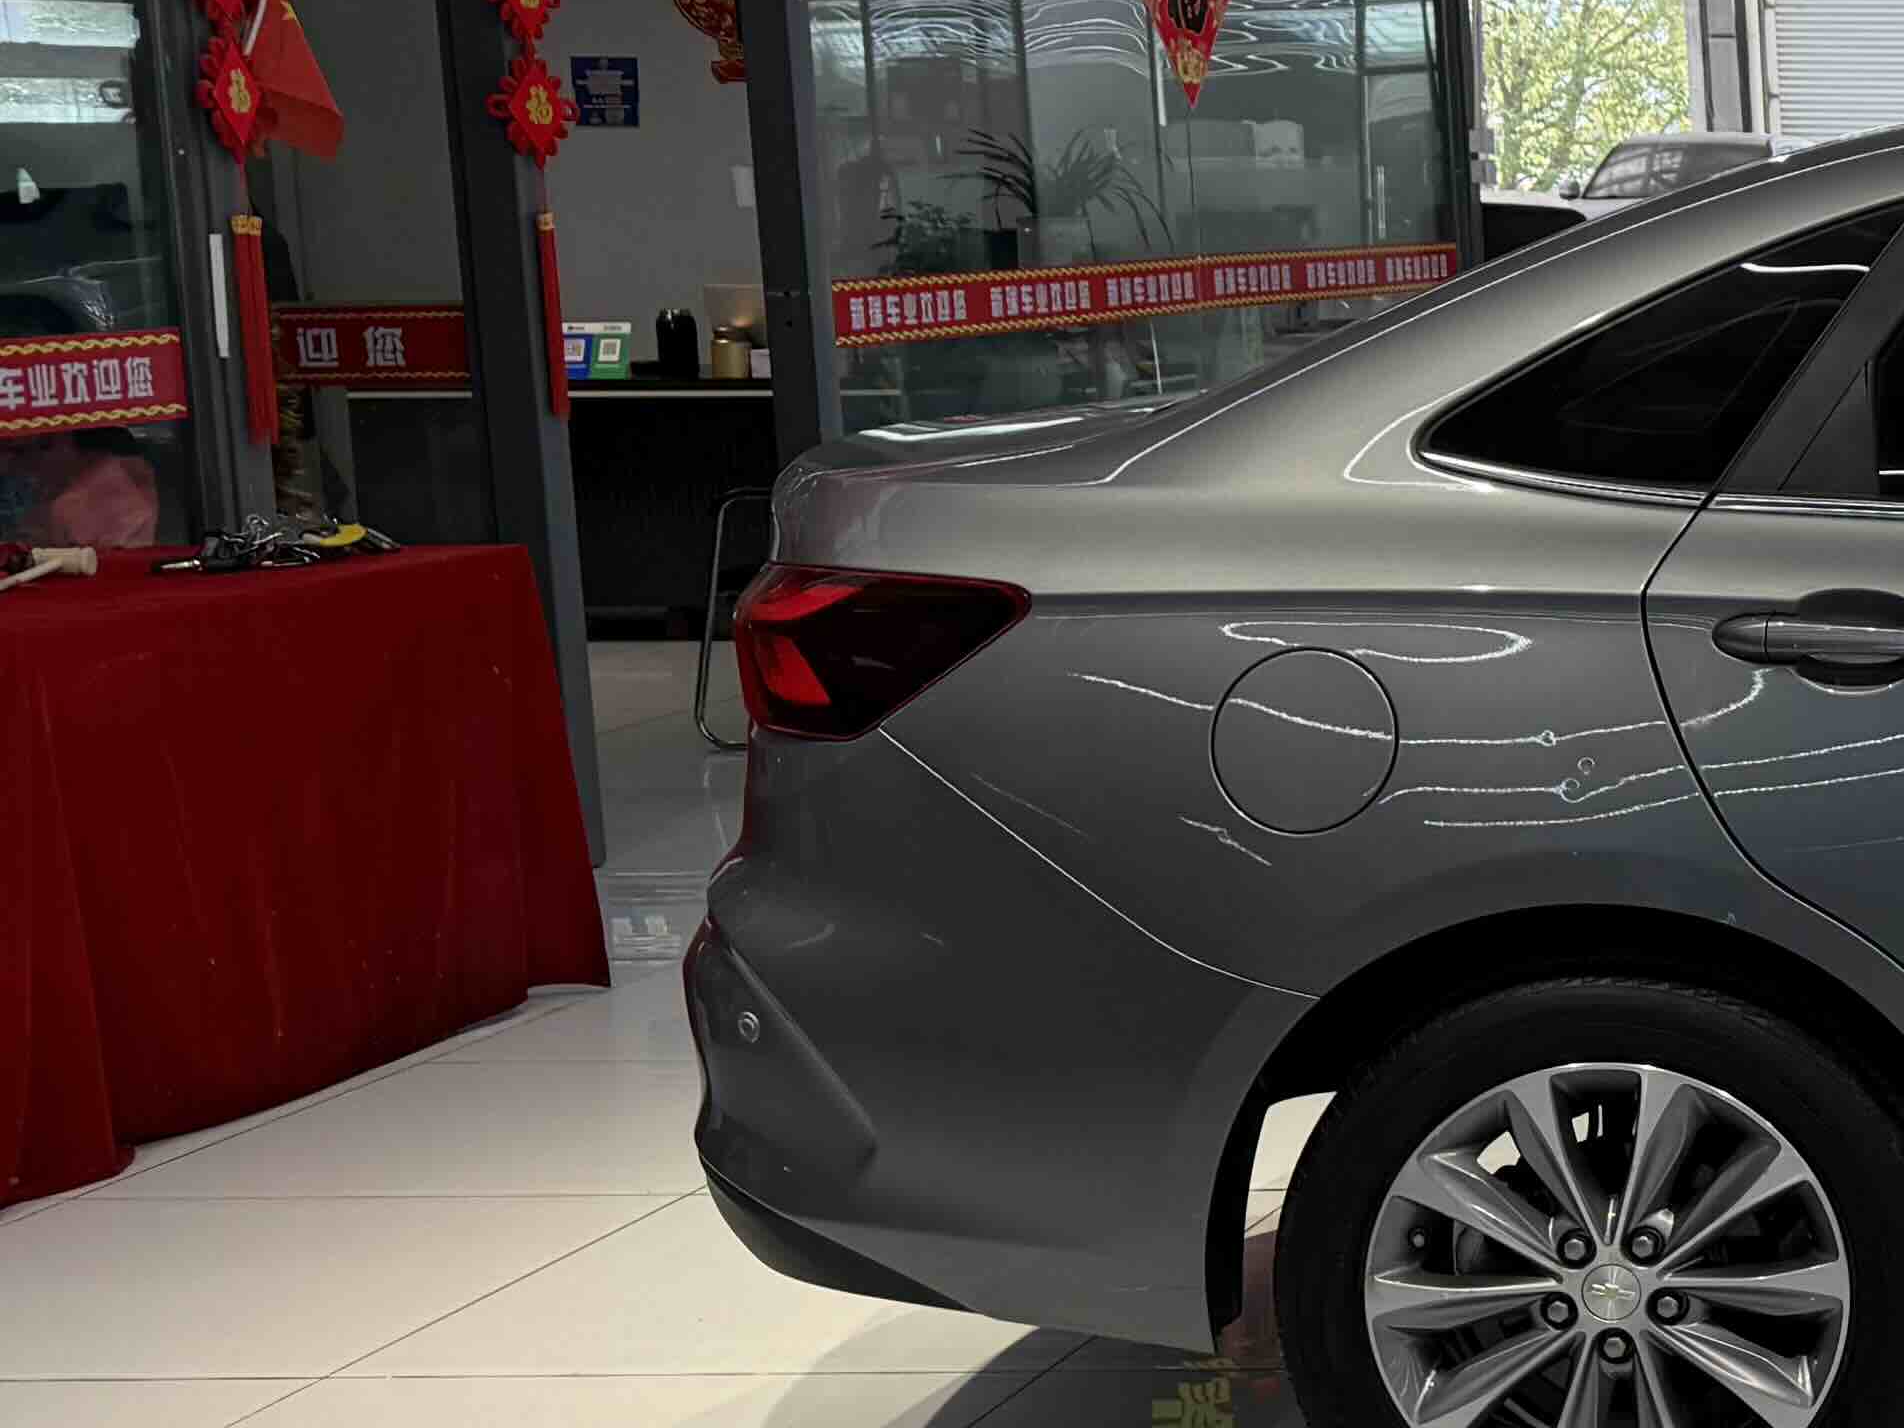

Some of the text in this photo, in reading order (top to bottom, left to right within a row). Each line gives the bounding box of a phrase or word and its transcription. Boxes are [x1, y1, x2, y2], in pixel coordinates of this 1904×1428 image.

[0, 356, 154, 411] 车业欢迎您
